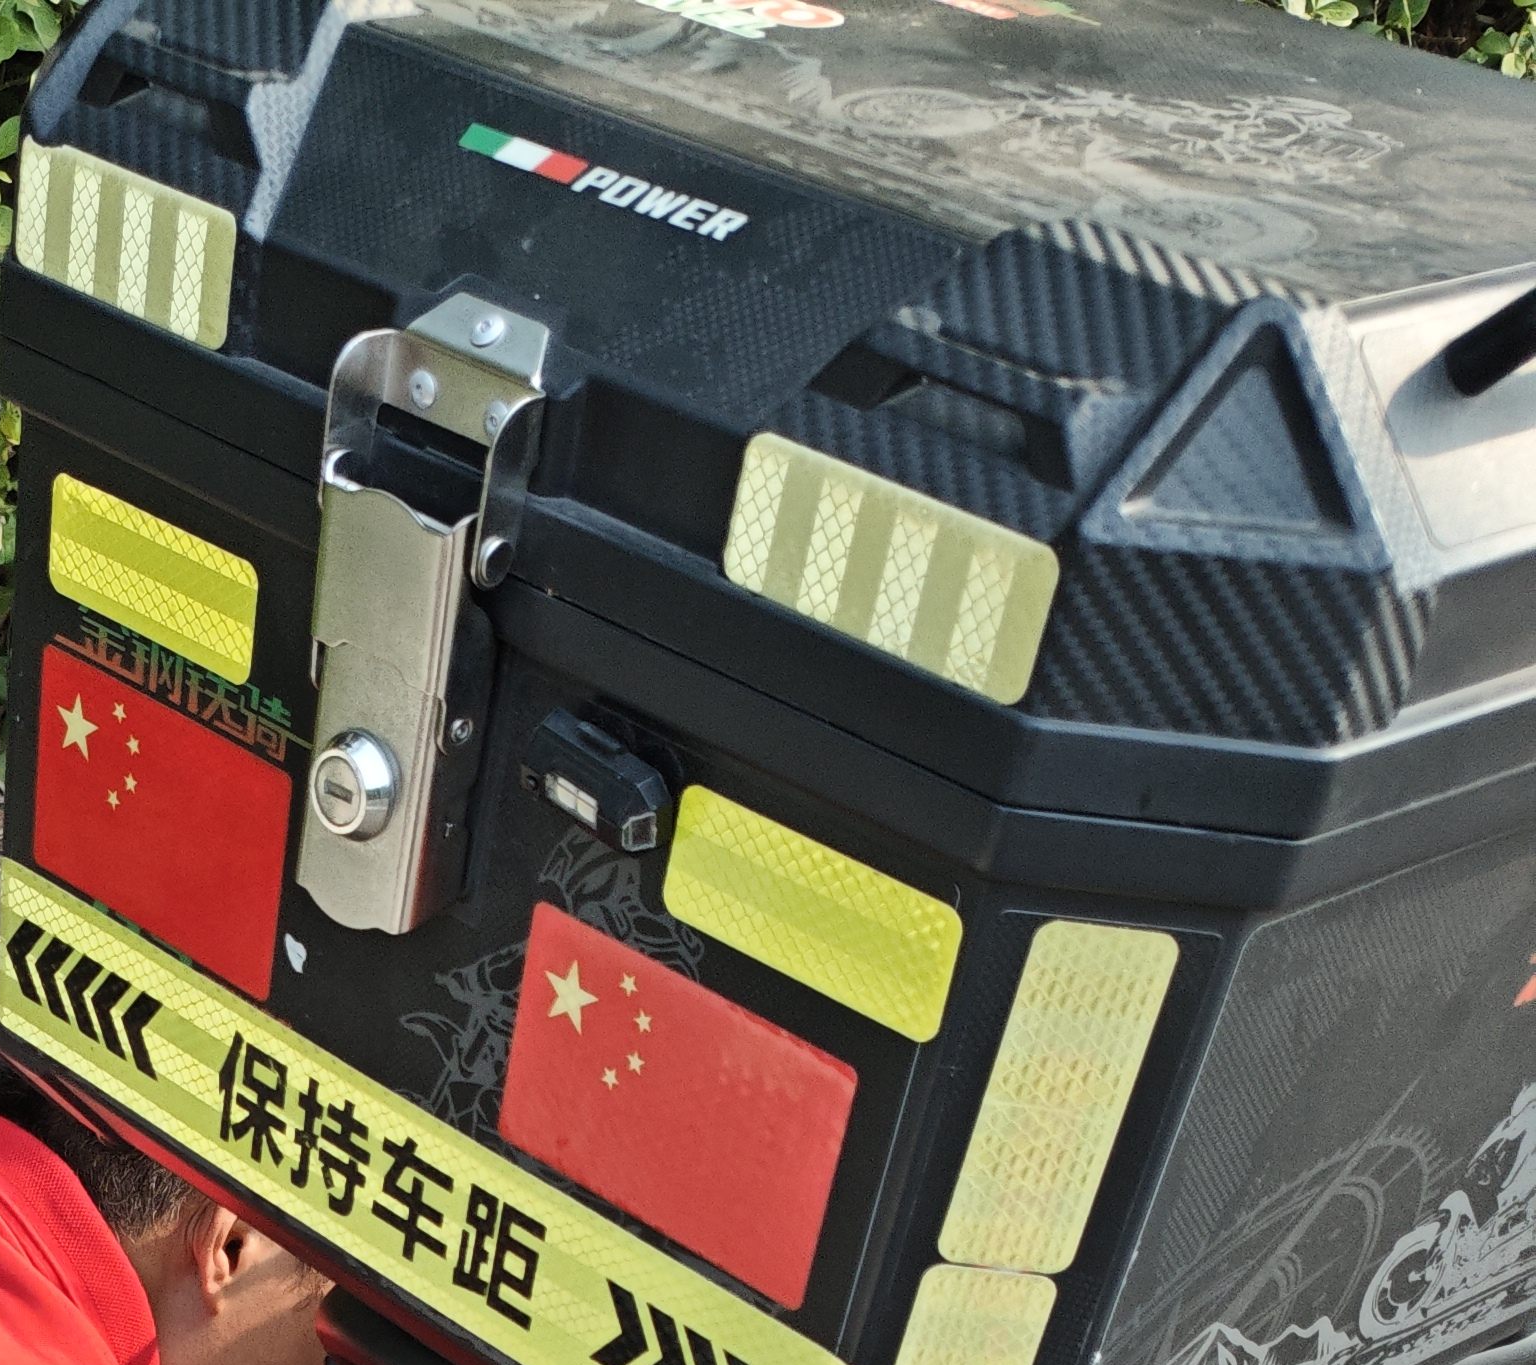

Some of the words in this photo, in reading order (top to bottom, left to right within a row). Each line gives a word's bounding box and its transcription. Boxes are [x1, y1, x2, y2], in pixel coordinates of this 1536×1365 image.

[571, 166, 749, 241] POWER
[219, 1030, 547, 1331] 保持车距
